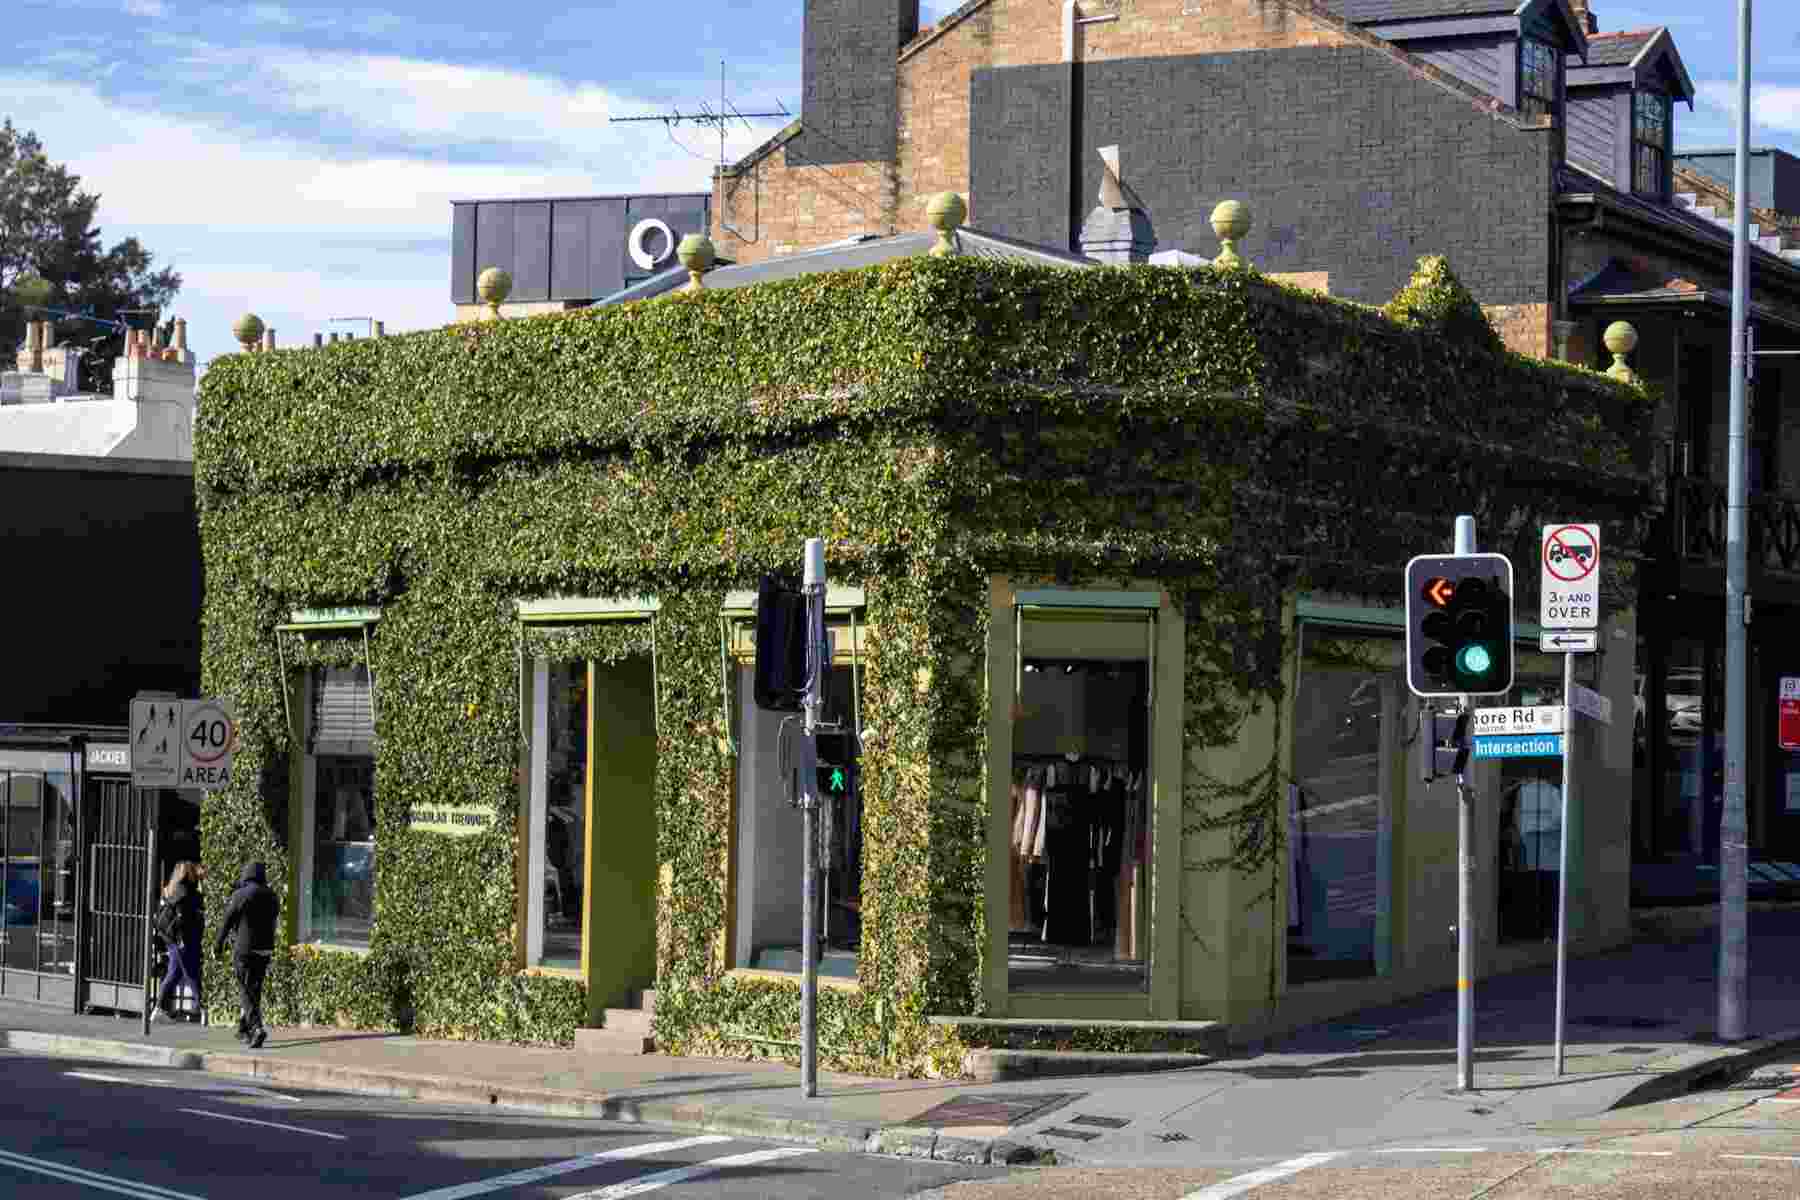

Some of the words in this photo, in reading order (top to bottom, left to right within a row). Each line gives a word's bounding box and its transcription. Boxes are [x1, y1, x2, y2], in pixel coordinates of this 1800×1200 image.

[1567, 593, 1592, 602] AND
[1548, 607, 1591, 618] OVER
[1513, 709, 1535, 723] Rd
[191, 719, 226, 747] 40
[1475, 739, 1554, 756] Intersection
[183, 768, 230, 784] AREA
